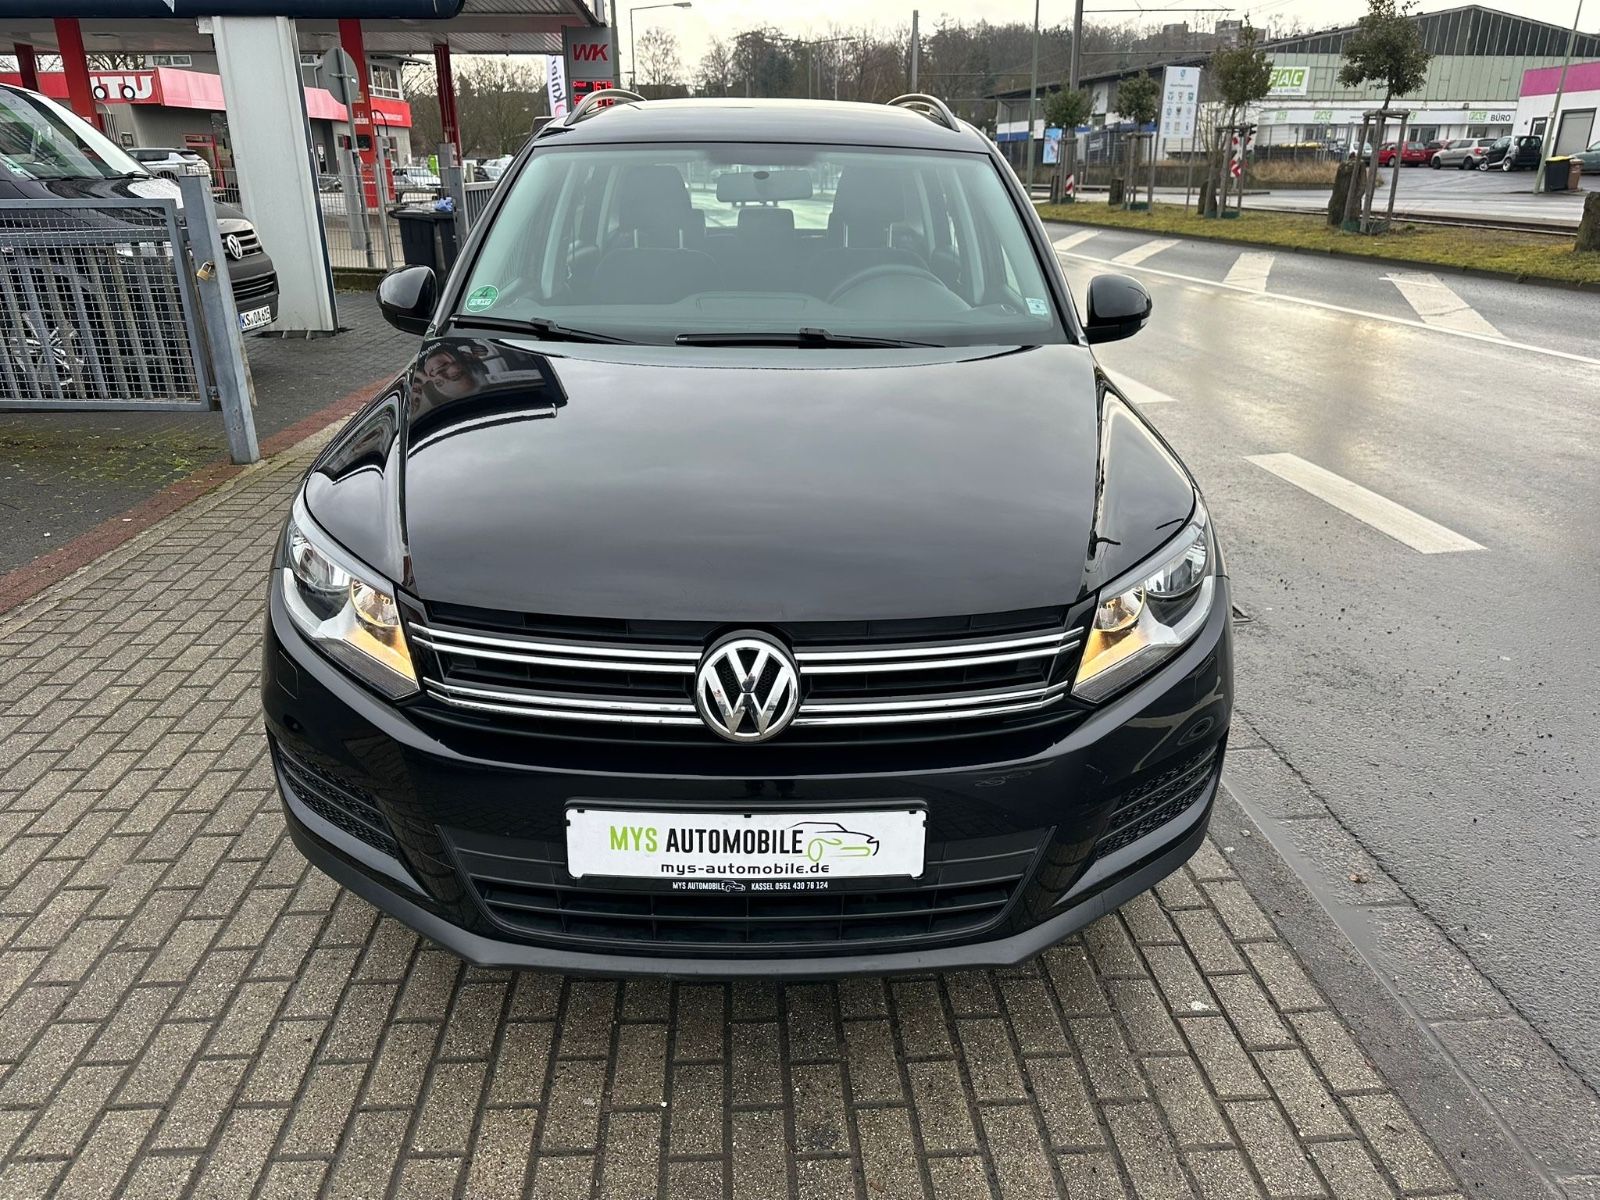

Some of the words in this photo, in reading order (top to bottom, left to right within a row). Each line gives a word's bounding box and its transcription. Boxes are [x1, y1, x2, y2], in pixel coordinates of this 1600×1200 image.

[573, 44, 608, 61] WK
[1267, 71, 1303, 85] FAC
[1490, 113, 1511, 122] BÜRO
[609, 826, 658, 852] MYS
[666, 828, 804, 854] AUTOMOBILE
[661, 863, 830, 875] mys-automobile.de
[672, 881, 686, 890] MYS
[687, 882, 725, 890] AUTOMOBILE
[751, 882, 774, 890] KASSEL
[793, 882, 805, 890] 430
[816, 881, 829, 889] 124
